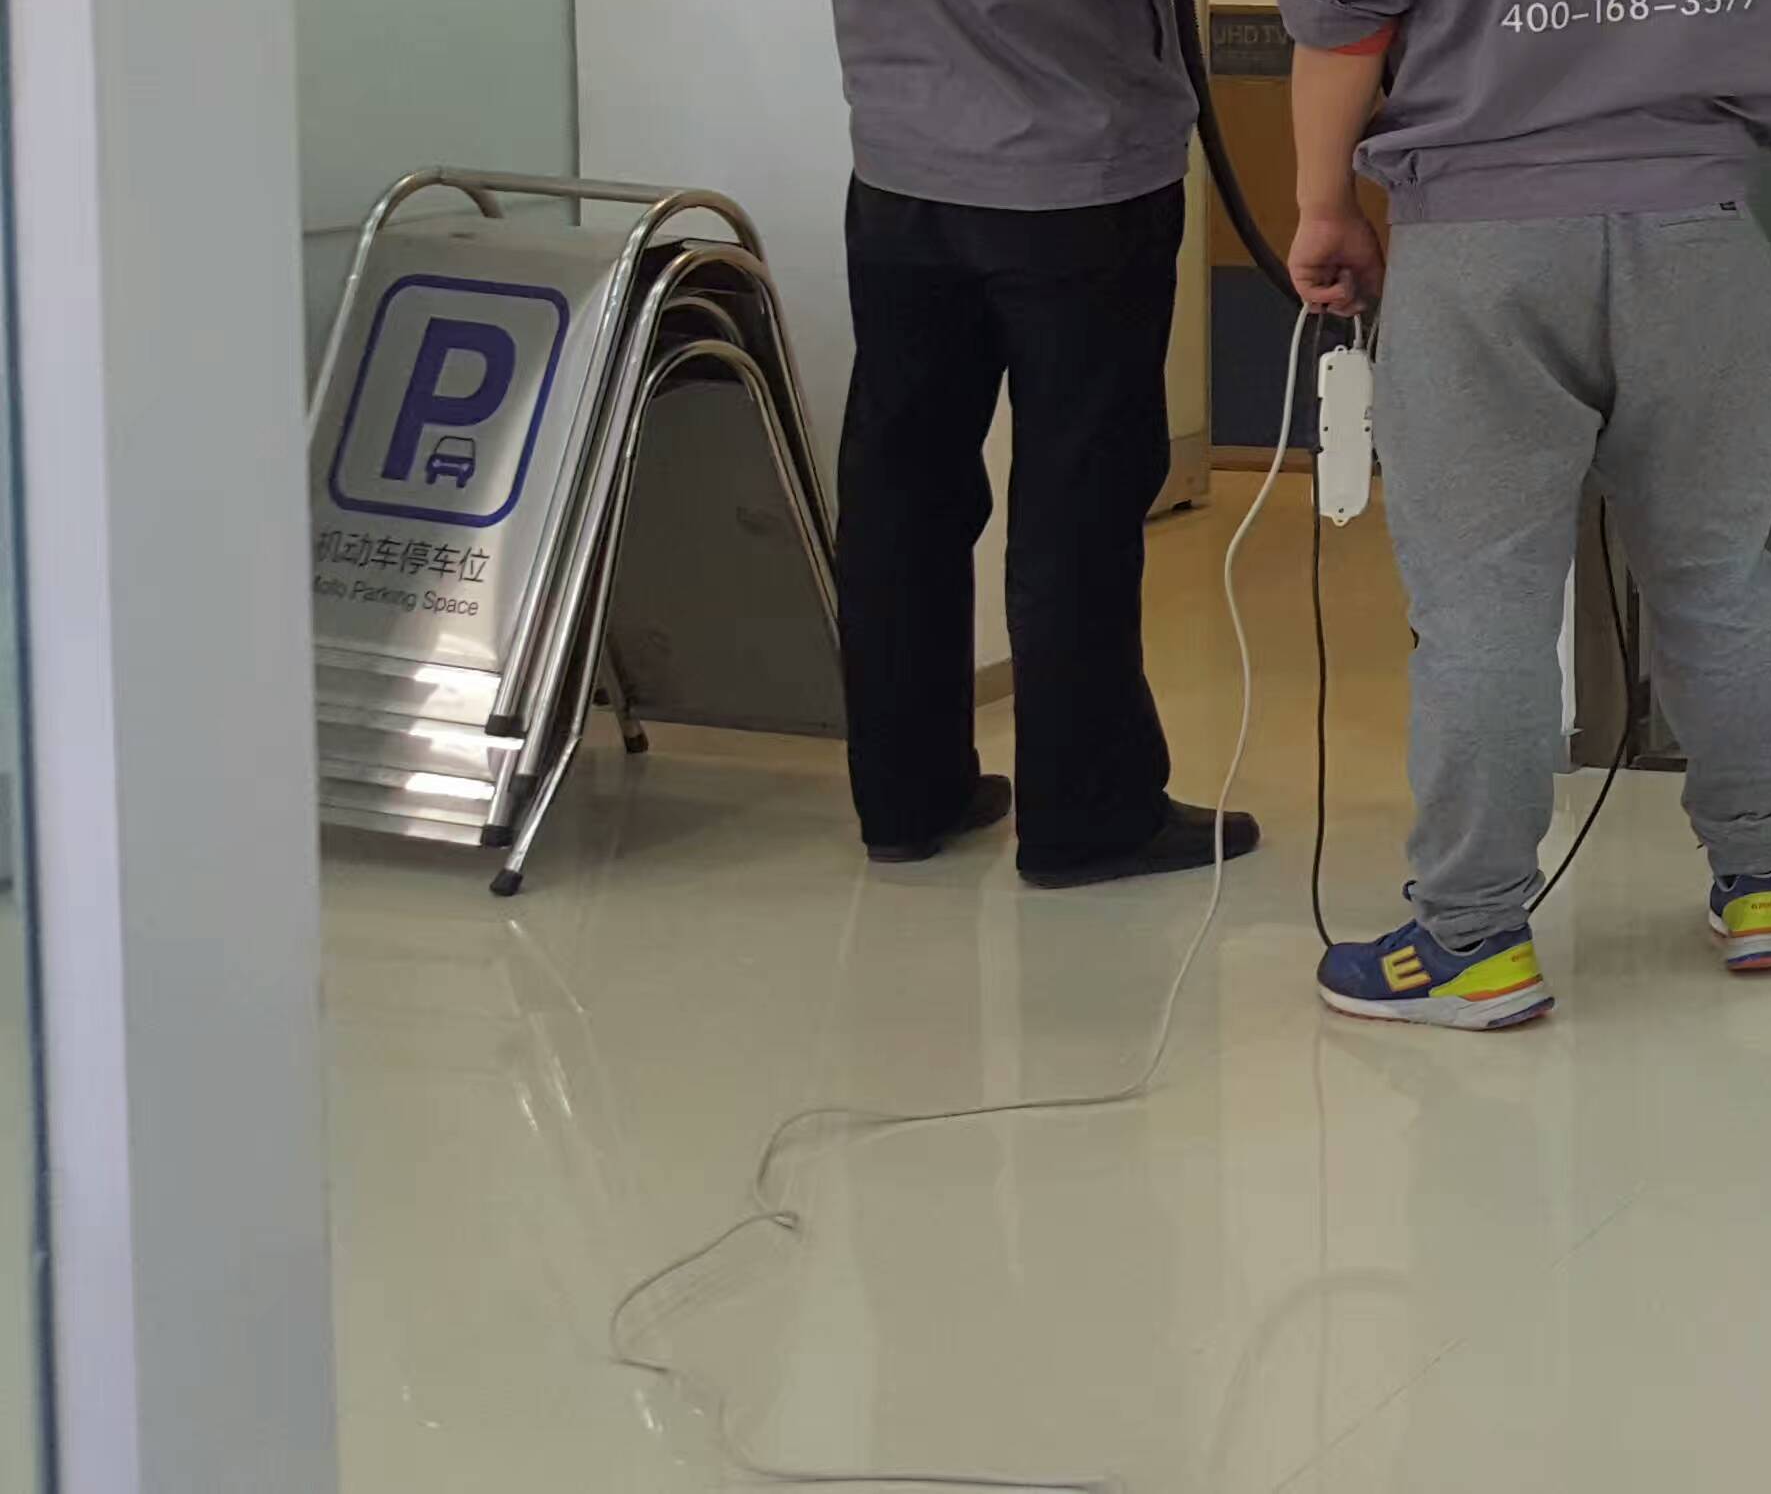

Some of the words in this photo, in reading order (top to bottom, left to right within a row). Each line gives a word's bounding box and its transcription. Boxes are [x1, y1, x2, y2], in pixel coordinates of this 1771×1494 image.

[379, 317, 517, 481] P
[315, 530, 491, 584] 机动车停车位
[423, 589, 479, 616] Space
